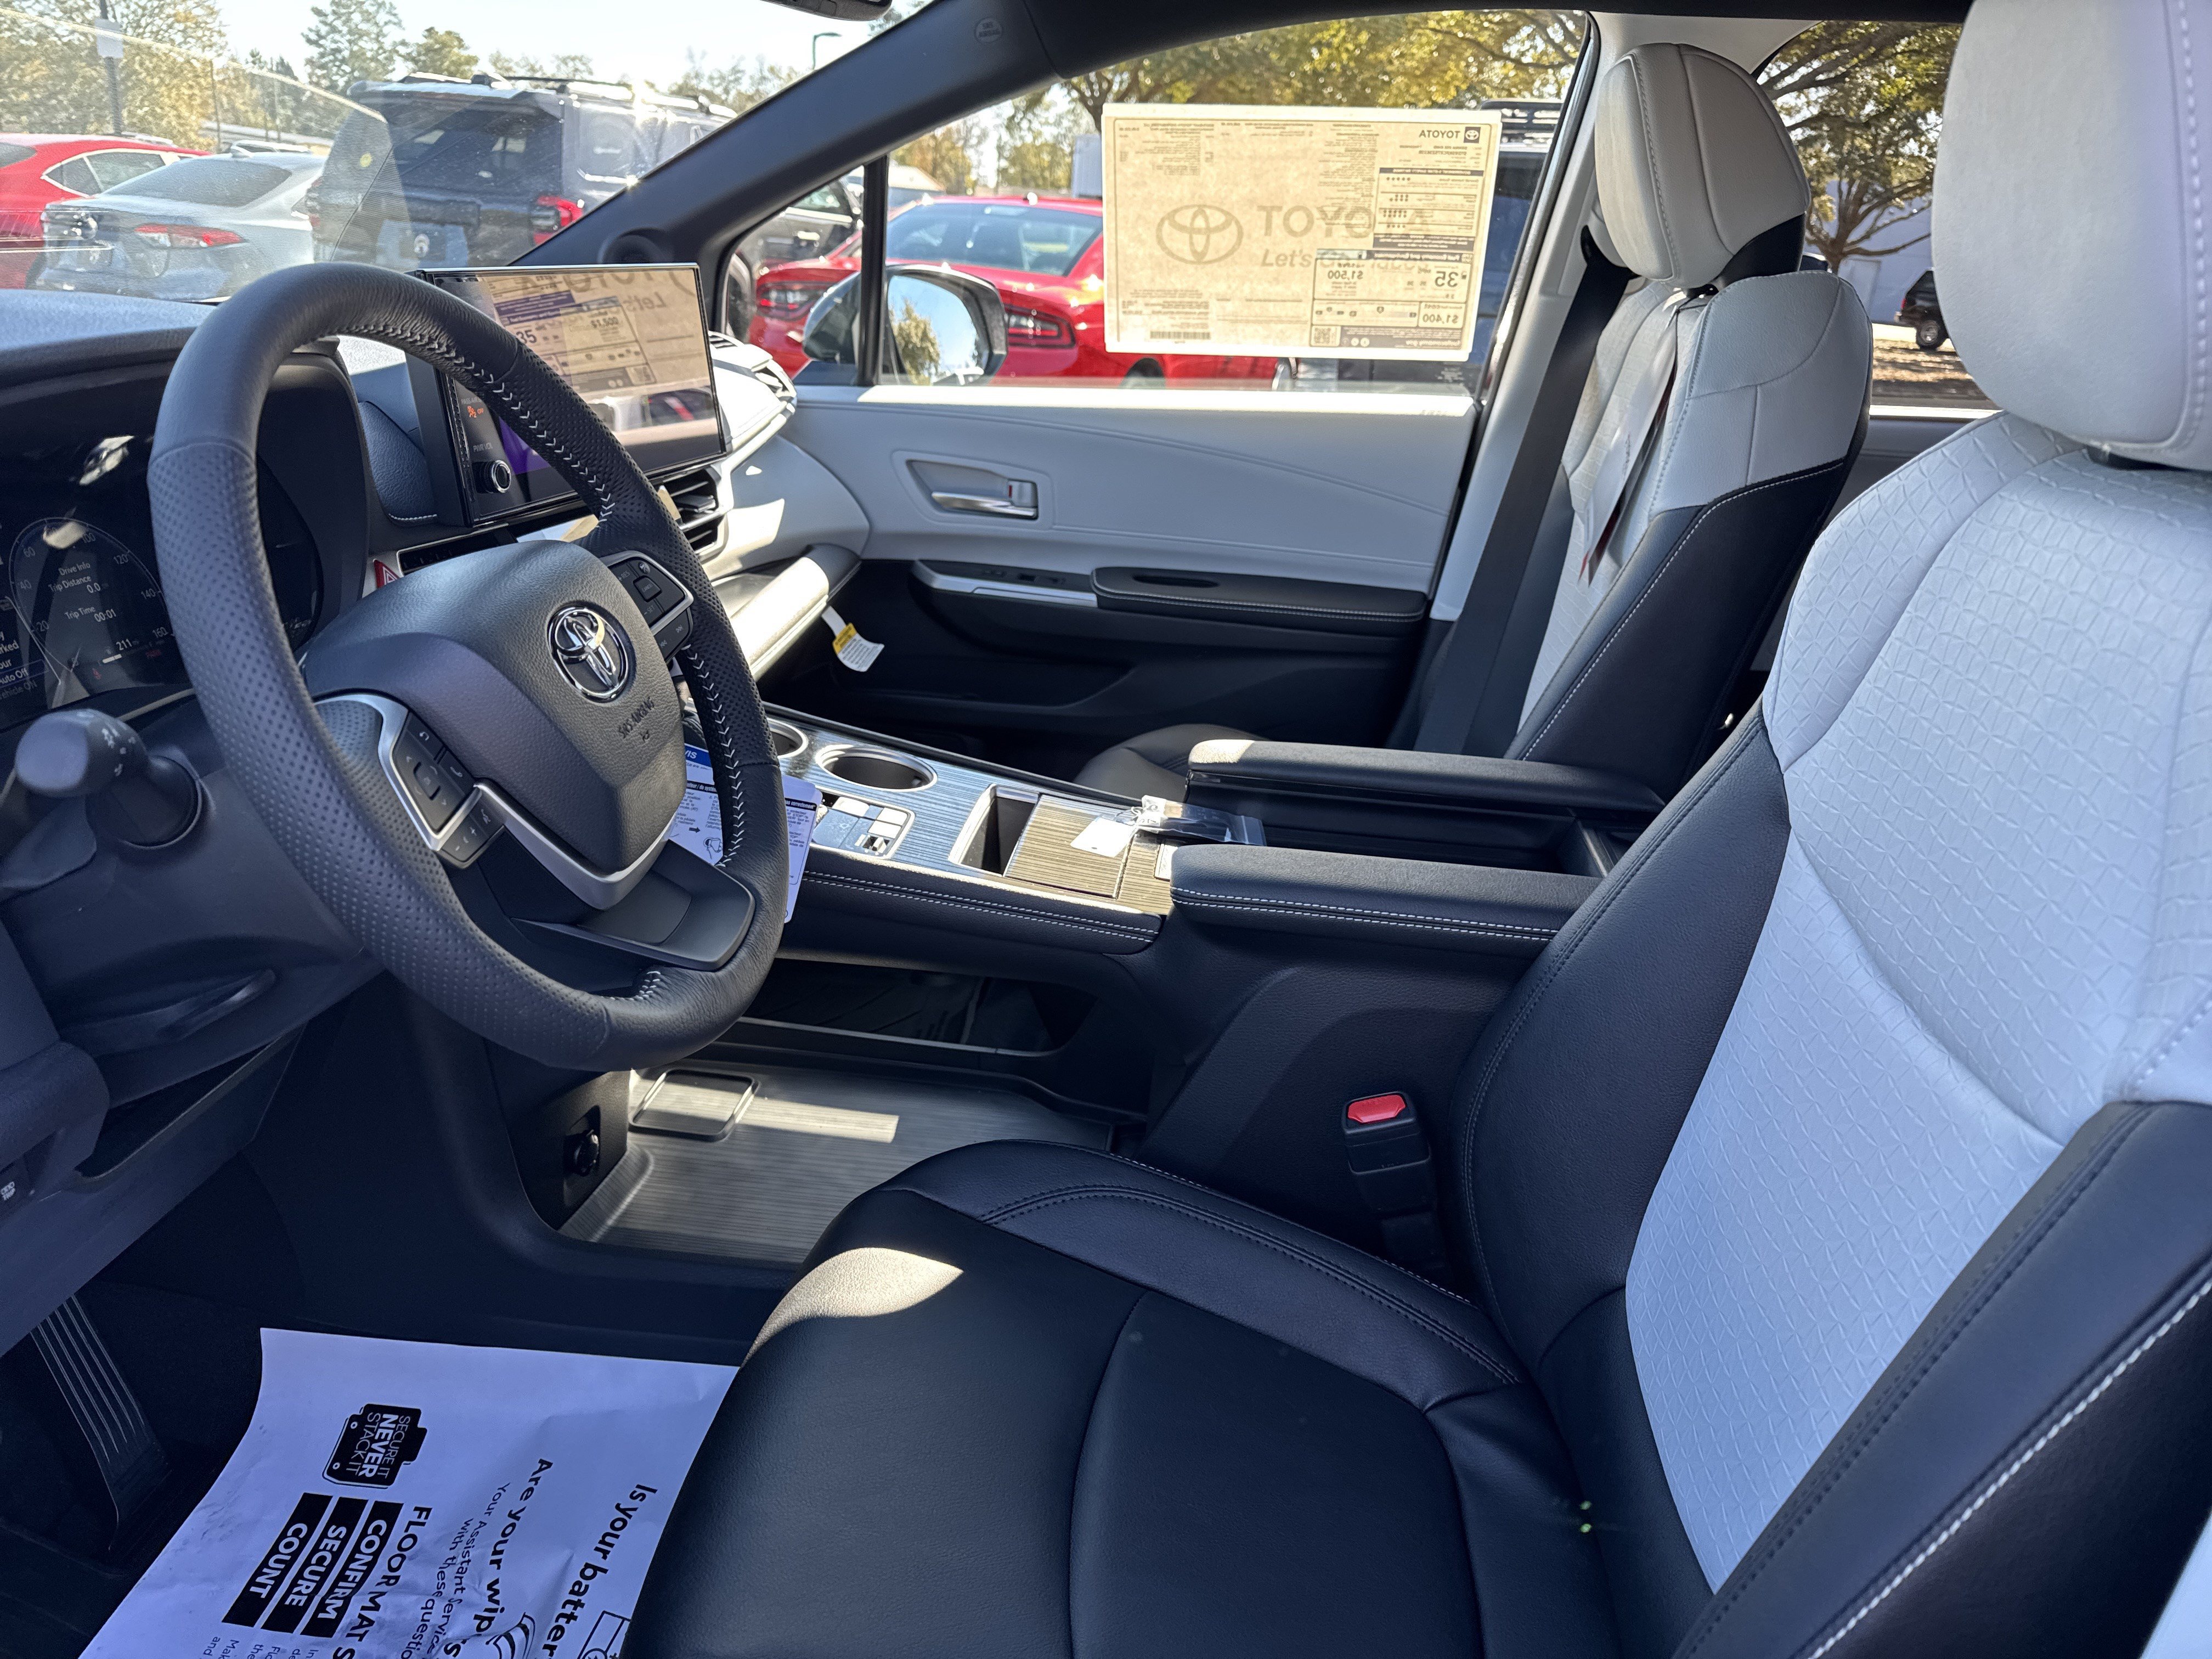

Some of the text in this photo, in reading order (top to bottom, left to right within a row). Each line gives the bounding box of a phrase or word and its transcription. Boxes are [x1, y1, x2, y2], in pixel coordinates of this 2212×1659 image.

[1261, 249, 1313, 268] Let's
[23, 546, 36, 558] 60
[113, 554, 129, 565] 120
[58, 561, 91, 577] Drive Info
[19, 579, 32, 590] 40
[48, 582, 63, 592] Trip
[64, 574, 92, 589] Distance
[87, 583, 101, 594] 0.0
[140, 588, 156, 600] 140
[64, 605, 96, 620] Trip Time
[93, 608, 117, 623] 00:01
[36, 620, 49, 632] 20
[152, 627, 168, 639] 160
[0, 640, 19, 654] rked
[116, 638, 133, 651] 211
[15, 667, 29, 679] Off
[346, 1412, 381, 1476] STACK IT
[358, 1413, 399, 1477] NEVER
[377, 1415, 410, 1479] SECURE IT
[519, 1458, 554, 1503] Are
[629, 1483, 658, 1502] Is
[449, 1517, 475, 1551] with
[489, 1505, 527, 1571] your
[593, 1502, 639, 1561] your
[375, 1505, 433, 1587] FLOOR
[249, 1522, 308, 1599] COUNT
[284, 1525, 347, 1607] SECURE
[317, 1519, 387, 1619] CONFIRM
[426, 1482, 511, 1655] Your Assistant Service
[431, 1555, 458, 1598] these
[345, 1590, 388, 1642] MAT
[202, 1636, 221, 1656] and
